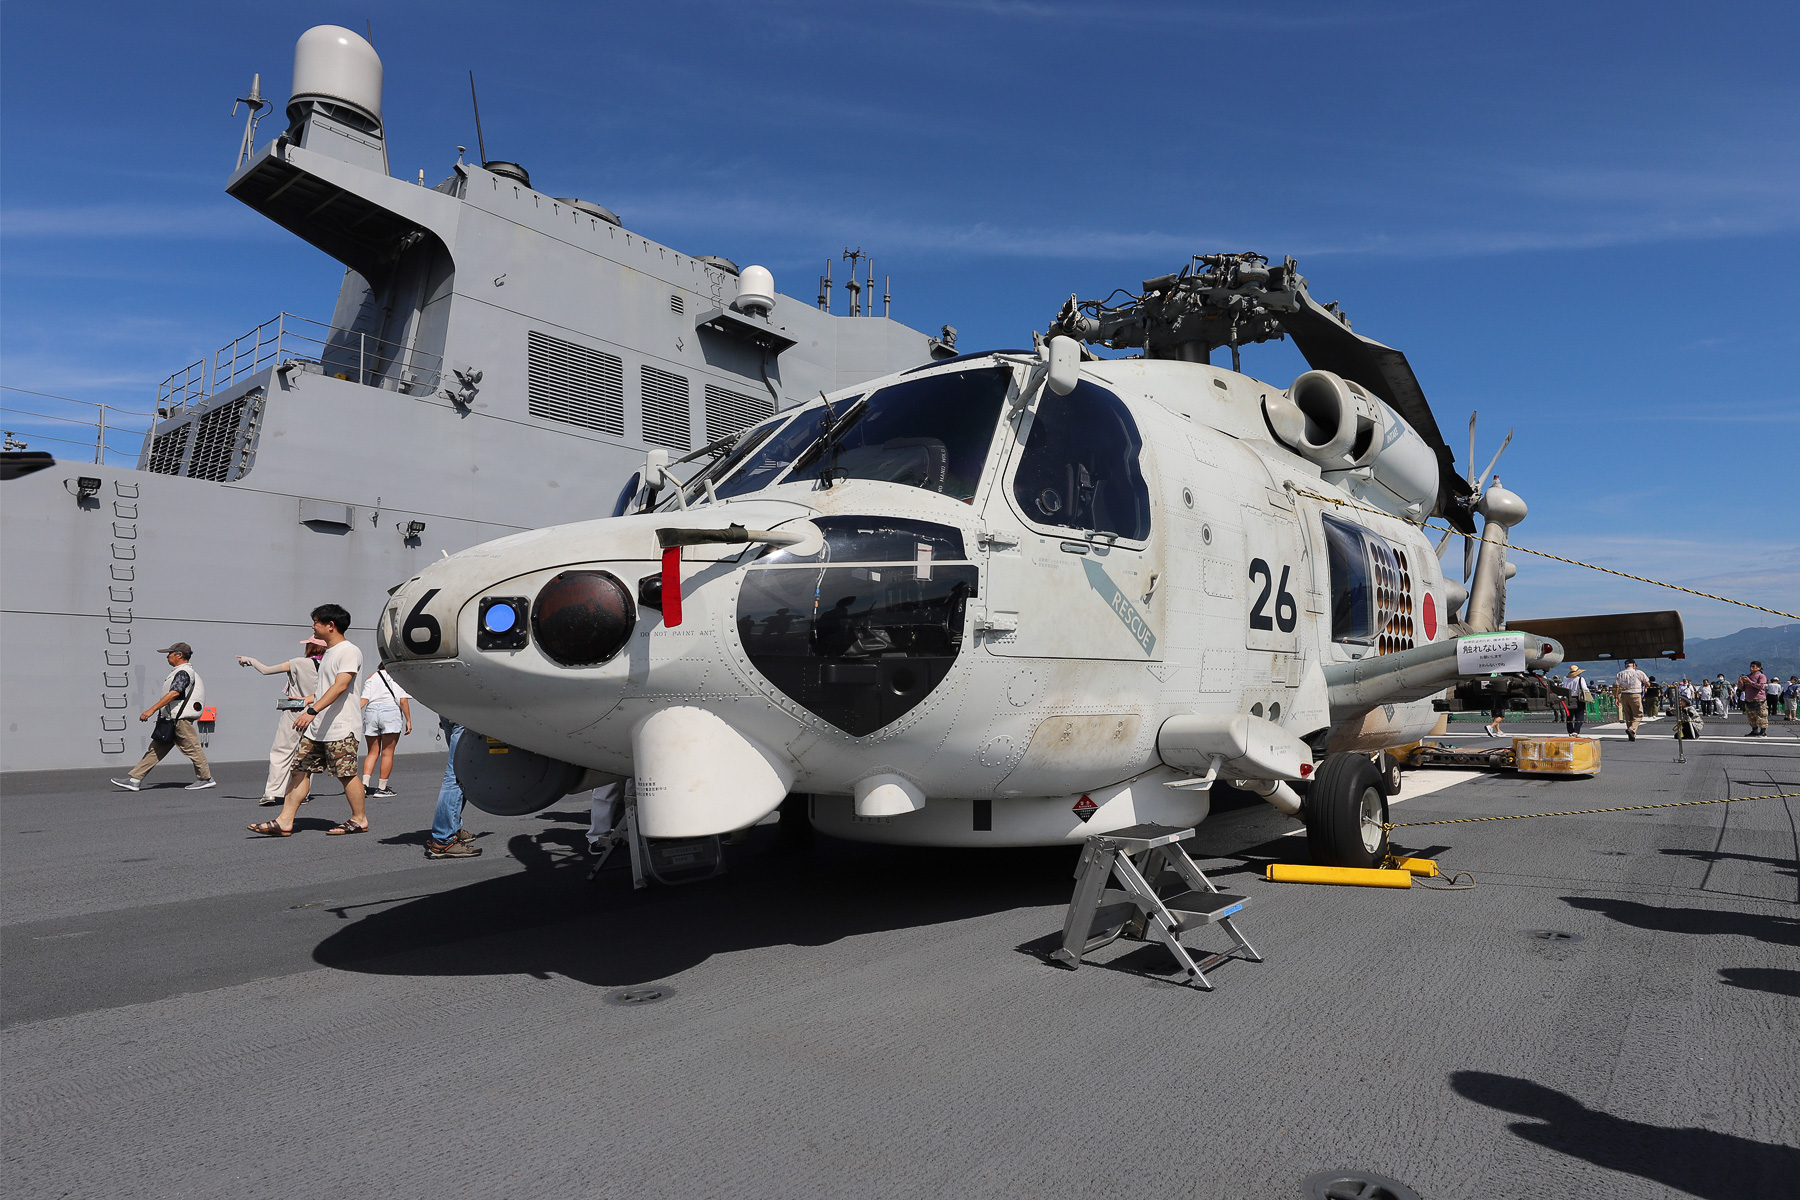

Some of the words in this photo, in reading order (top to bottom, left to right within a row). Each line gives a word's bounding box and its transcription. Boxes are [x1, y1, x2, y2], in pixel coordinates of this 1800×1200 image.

[402, 588, 441, 655] 6
[1111, 591, 1153, 648] RESCUE
[1248, 557, 1297, 633] 26
[1463, 641, 1518, 654] 触れないよう
